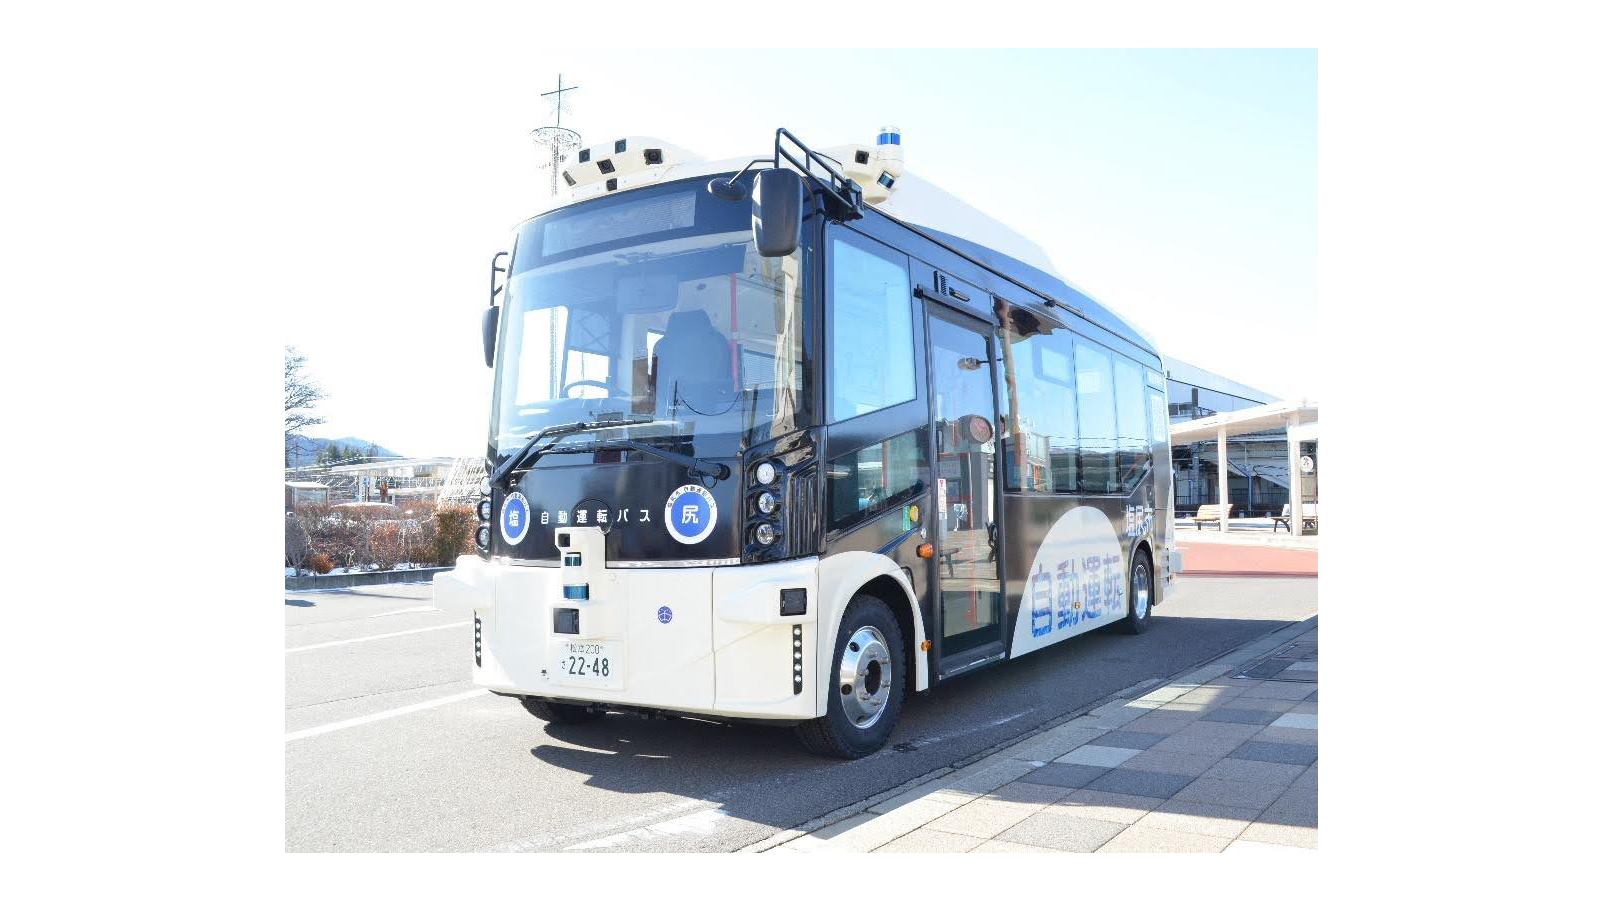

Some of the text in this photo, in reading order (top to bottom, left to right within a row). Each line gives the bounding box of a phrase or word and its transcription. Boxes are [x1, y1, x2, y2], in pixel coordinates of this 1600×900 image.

[508, 509, 520, 527] 塩
[540, 508, 651, 525] 自動運転バス
[681, 504, 699, 524] 尻
[1031, 552, 1120, 638] 自動運転
[568, 655, 610, 677] 22-48
